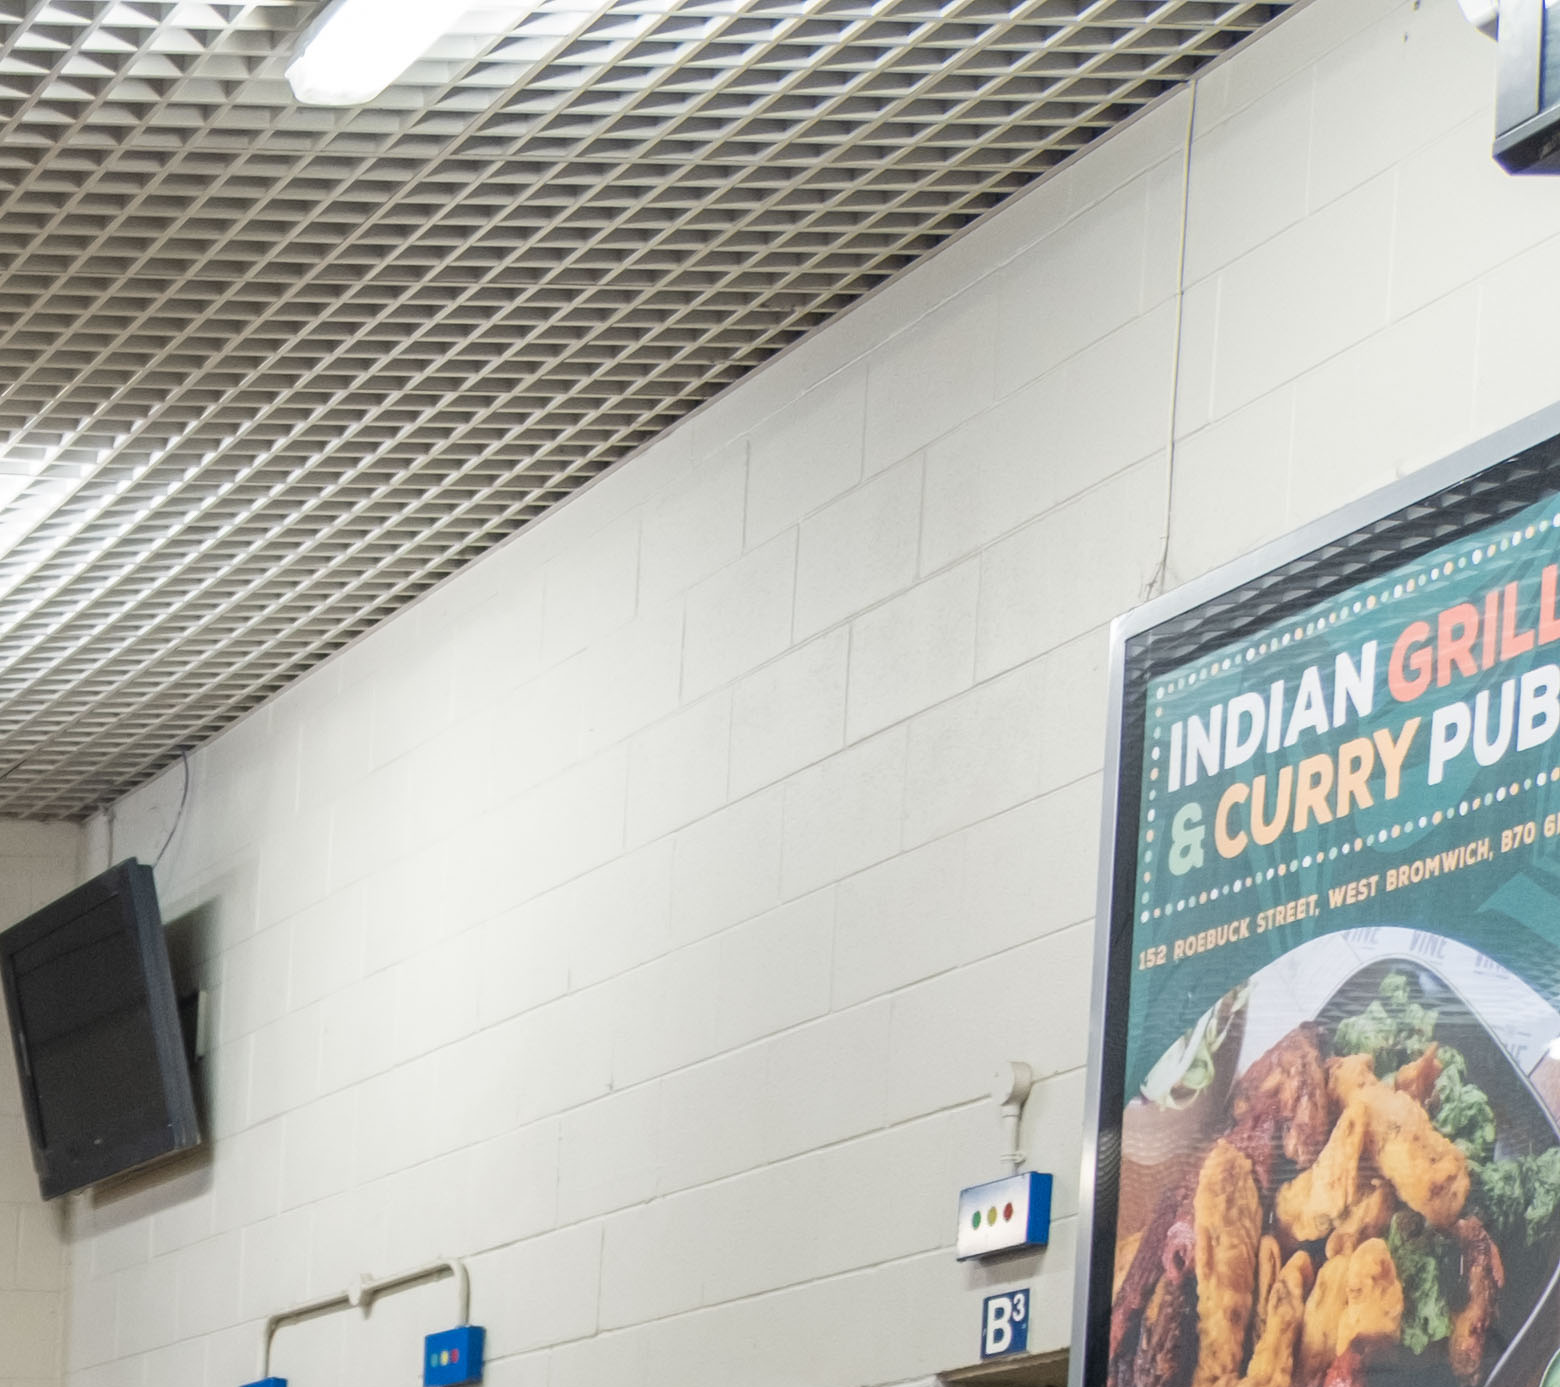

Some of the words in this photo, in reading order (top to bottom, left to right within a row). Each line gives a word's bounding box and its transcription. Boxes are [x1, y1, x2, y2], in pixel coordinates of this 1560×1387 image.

[1168, 640, 1378, 793] INDIAN
[1387, 563, 1560, 703] GRILL
[1168, 803, 1206, 876] &
[1215, 717, 1421, 859] CURRY
[1427, 664, 1560, 786] PUB
[1138, 945, 1167, 971] 152
[1173, 917, 1250, 959] ROEBUCK
[1256, 894, 1320, 934] STREET,
[1328, 875, 1379, 909] WEST
[1386, 837, 1494, 893] BROMWICH,
[1500, 821, 1536, 854] B70
